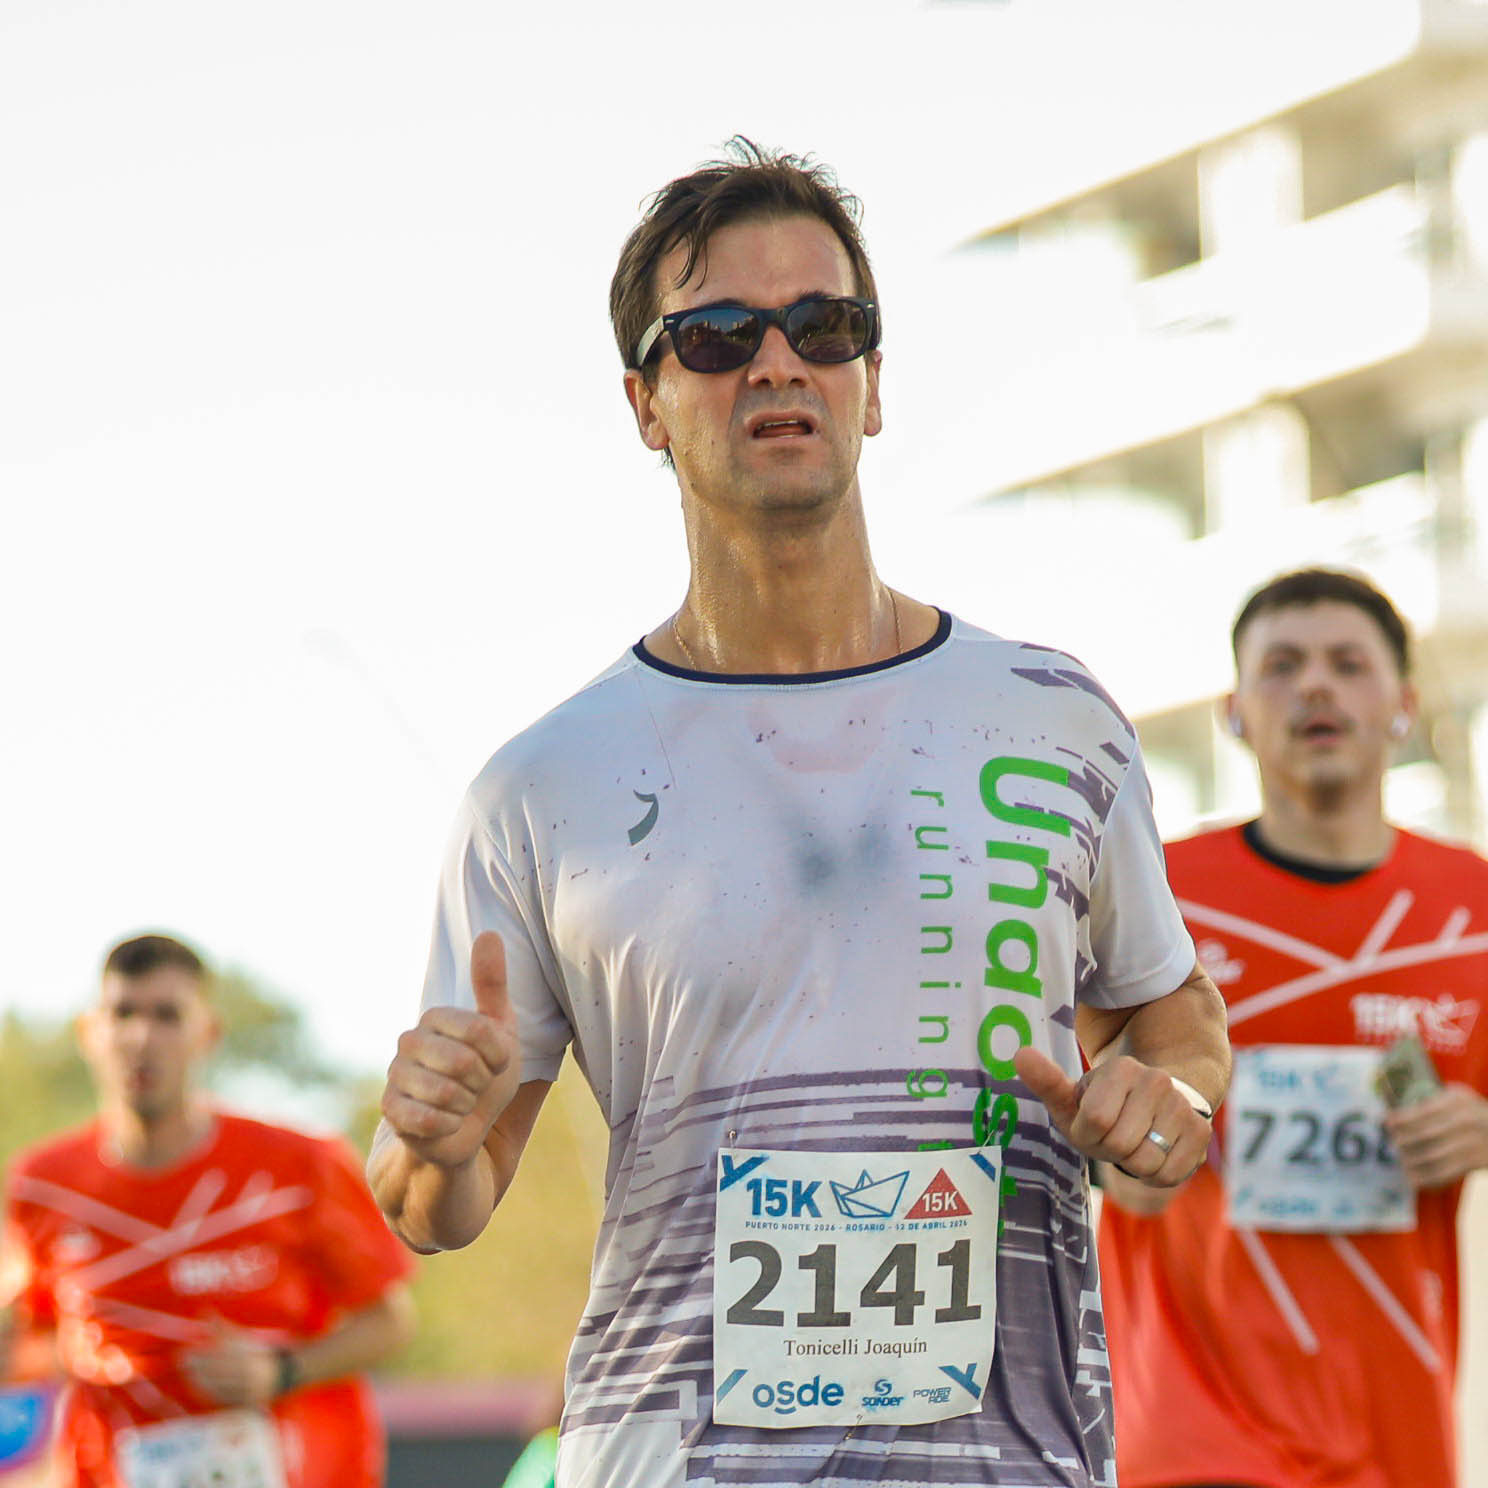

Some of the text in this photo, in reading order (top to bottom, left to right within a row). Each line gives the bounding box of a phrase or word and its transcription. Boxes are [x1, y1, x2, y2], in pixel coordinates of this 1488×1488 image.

[907, 789, 962, 1098] running
[746, 1178, 823, 1217] 15K
[922, 1190, 959, 1212] 15K
[745, 1221, 779, 1230] PUERTO
[781, 1223, 810, 1231] NORTE
[846, 1223, 885, 1231] ROSARIO
[908, 1222, 918, 1230] DE
[922, 1221, 946, 1230] ABRIL
[726, 1239, 982, 1328] 2141
[783, 1337, 928, 1358] Tonicelli Joaquín
[752, 1374, 845, 1408] osde
[913, 1386, 952, 1398] POWER
